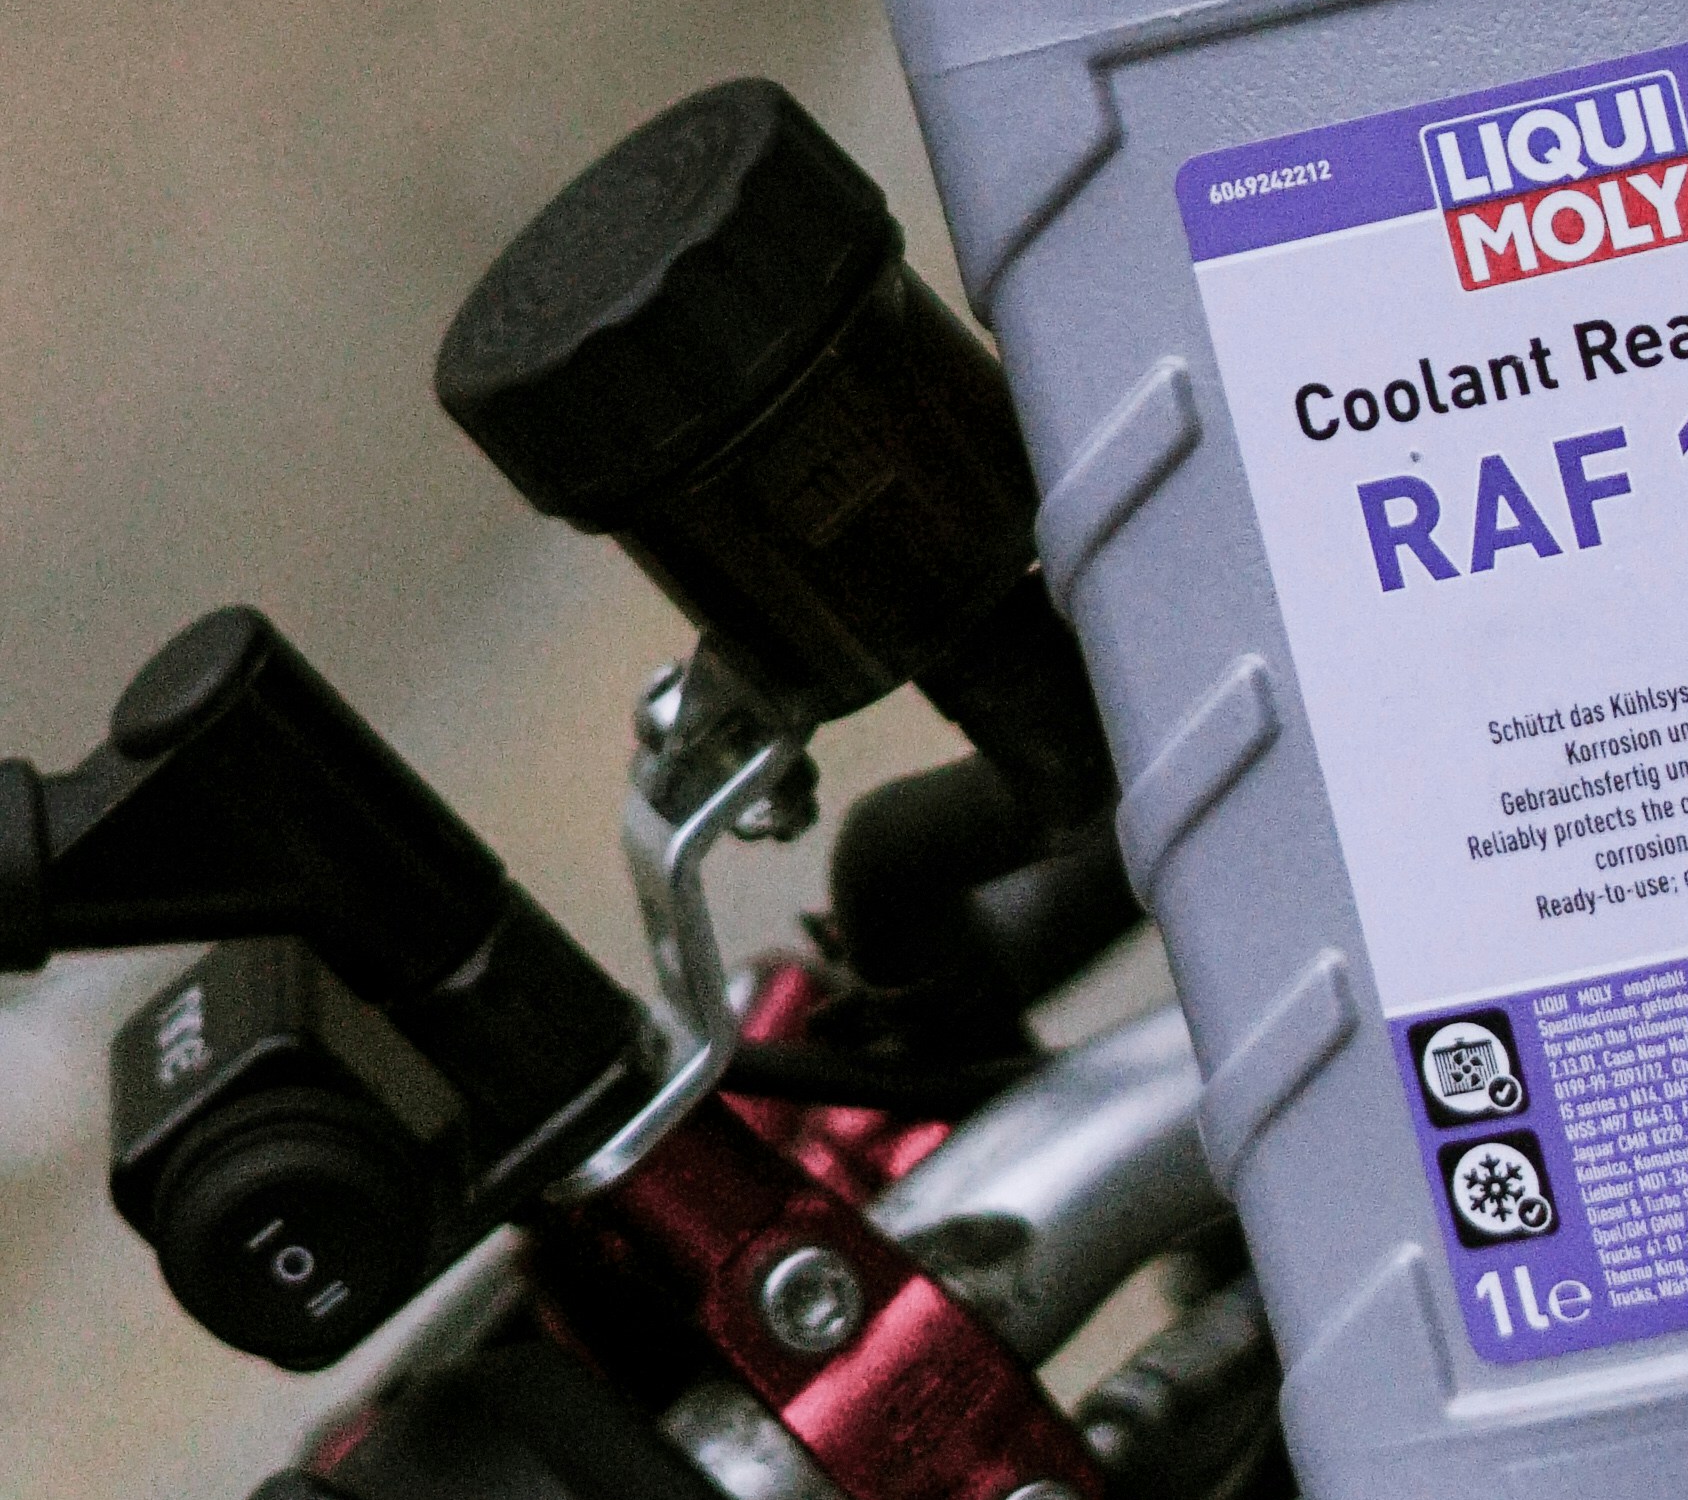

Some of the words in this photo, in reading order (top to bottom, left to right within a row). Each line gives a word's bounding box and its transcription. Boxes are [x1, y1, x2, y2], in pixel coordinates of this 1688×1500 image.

[1435, 82, 1676, 202] LIQUI
[1209, 159, 1332, 204] 6069242212
[1456, 162, 1688, 284] MOLY
[1294, 336, 1559, 441] Coolant
[1356, 425, 1632, 592] RAF
[1487, 708, 1565, 745] Schützt
[1569, 703, 1605, 728] das
[1564, 728, 1662, 765] Korrosion
[1500, 762, 1661, 816] Gebrauchsfertig
[1466, 823, 1547, 860] Reliably
[1553, 806, 1637, 848] protects
[1640, 798, 1675, 822] the
[1594, 833, 1688, 870] corrosion
[1535, 875, 1678, 919] Ready-to-use;
[1576, 983, 1613, 1007] MOLY
[1542, 1041, 1563, 1058] for
[1564, 1029, 1604, 1054] which
[1603, 1026, 1628, 1045] the
[1602, 1048, 1635, 1067] Case
[1636, 1041, 1666, 1060] New
[1576, 1095, 1616, 1117] series
[1570, 1140, 1616, 1163] Jaguar
[1586, 1200, 1627, 1225] Diesel
[1643, 1190, 1681, 1212] Turbo
[1598, 1242, 1642, 1265] Trucks
